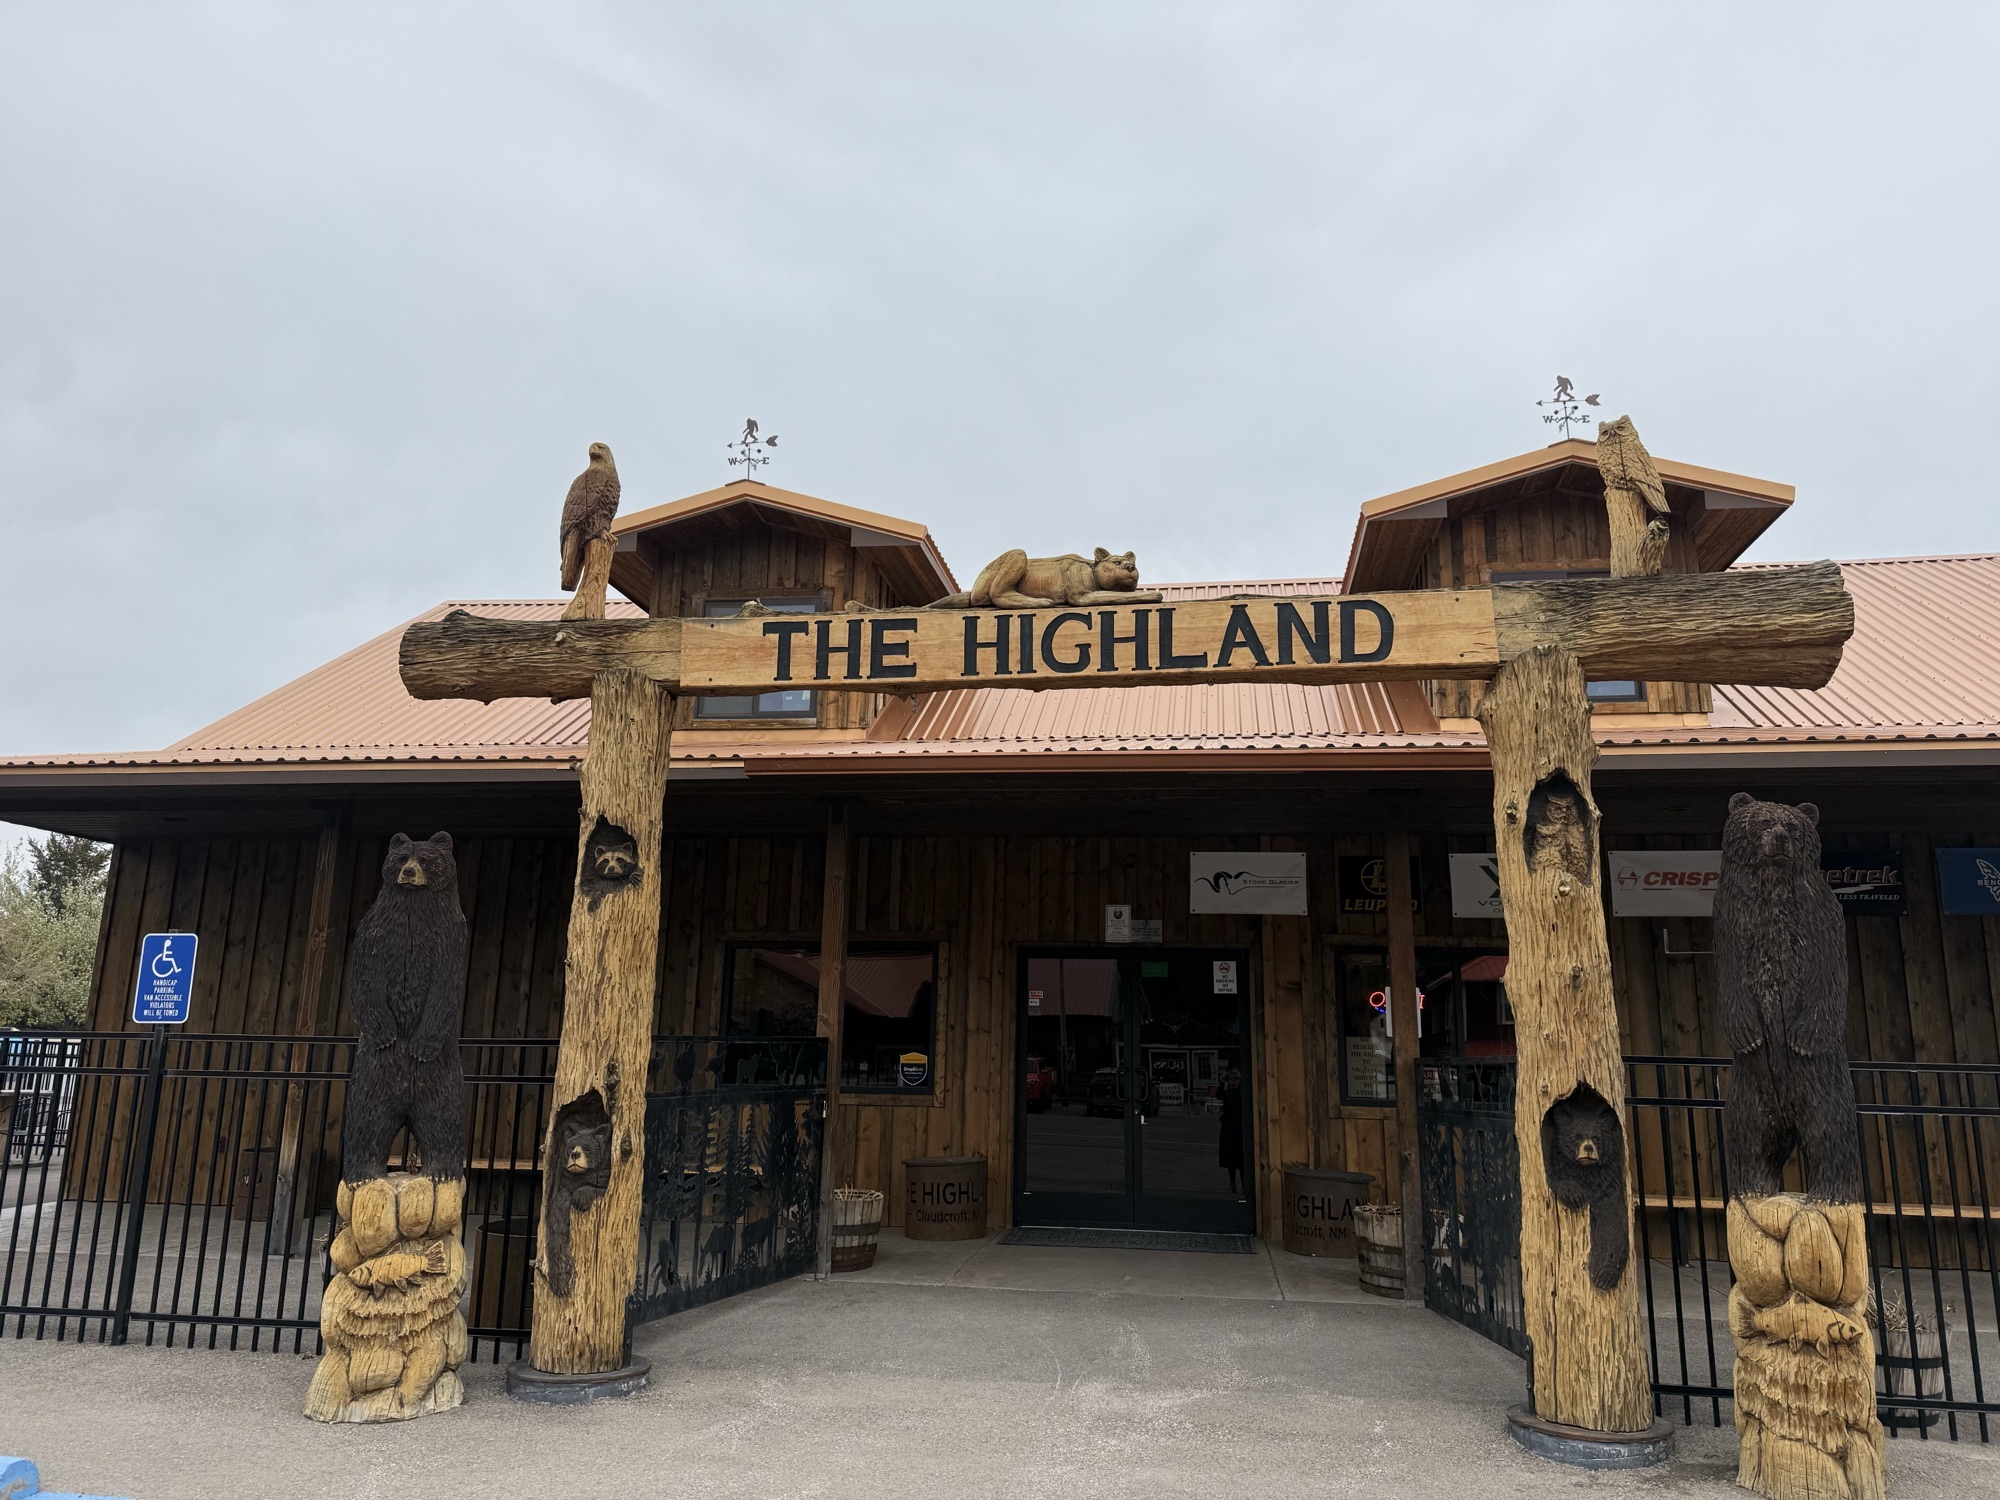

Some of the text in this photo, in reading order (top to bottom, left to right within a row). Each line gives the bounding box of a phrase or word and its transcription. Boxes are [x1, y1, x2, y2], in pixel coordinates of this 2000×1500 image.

[1542, 415, 1590, 423] W E
[727, 457, 737, 465] W
[762, 600, 1394, 681] THE HIGHLAND
[1643, 871, 1720, 886] CRISP
[1344, 898, 1418, 911] LEUPD
[1329, 1226, 1348, 1239] NM
